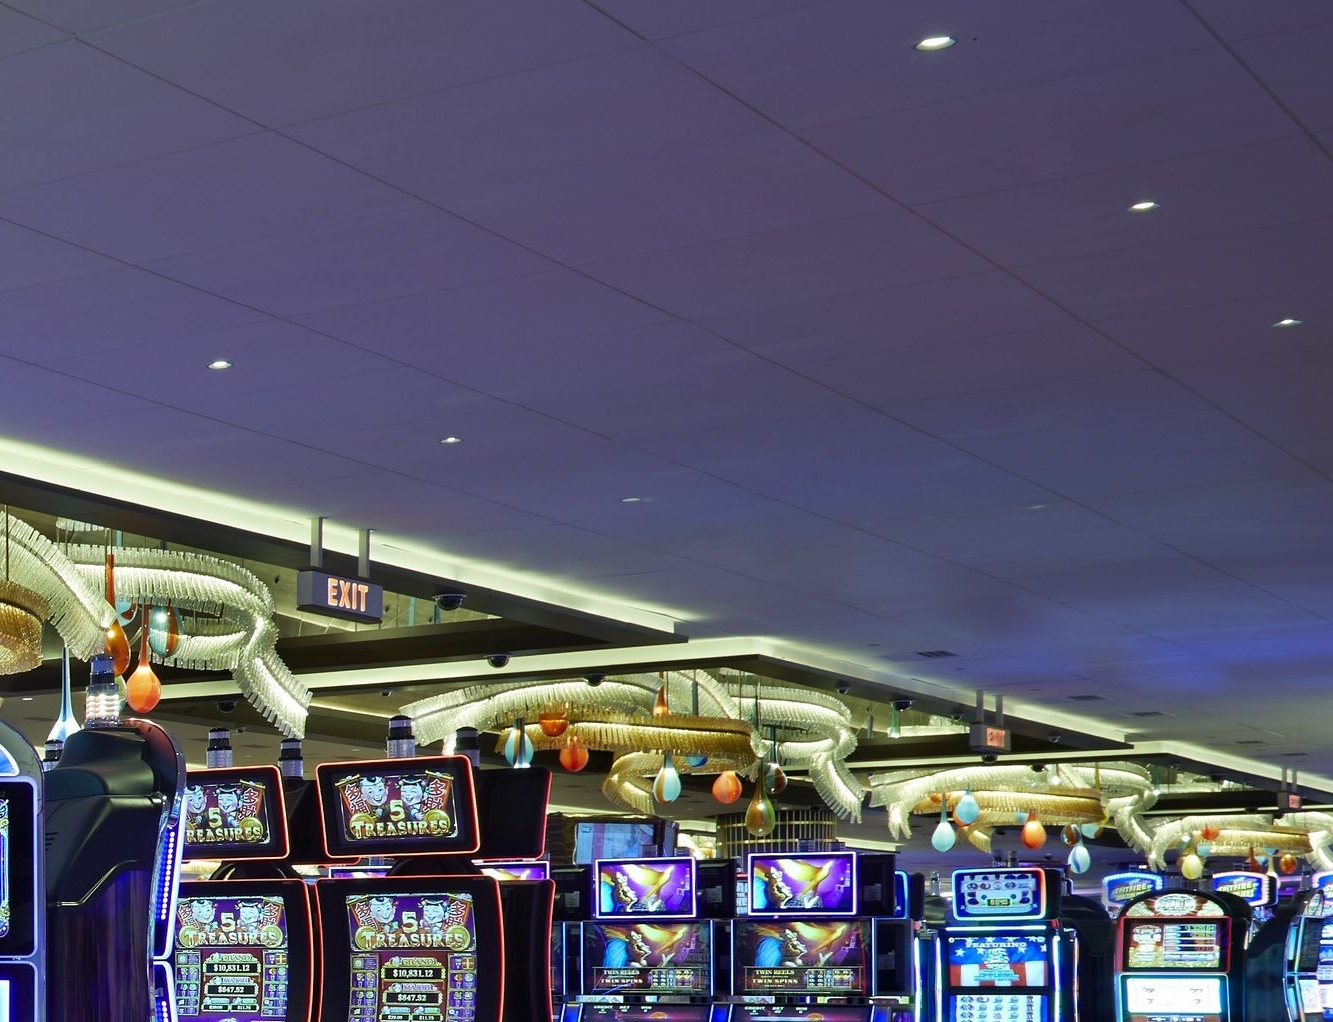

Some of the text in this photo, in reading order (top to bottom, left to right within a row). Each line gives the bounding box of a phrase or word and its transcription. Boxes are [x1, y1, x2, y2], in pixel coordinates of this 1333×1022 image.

[327, 577, 369, 612] EXIT
[208, 807, 222, 828] 5
[389, 800, 405, 821] 5
[185, 827, 262, 842] REASURES
[351, 820, 449, 839] TREASURES
[220, 912, 236, 932] 5
[402, 911, 418, 933] 5
[184, 929, 277, 945] TREASURES
[361, 930, 464, 948] TREASURES
[213, 964, 250, 973] $10,831.12
[393, 969, 433, 978] $10,831.12
